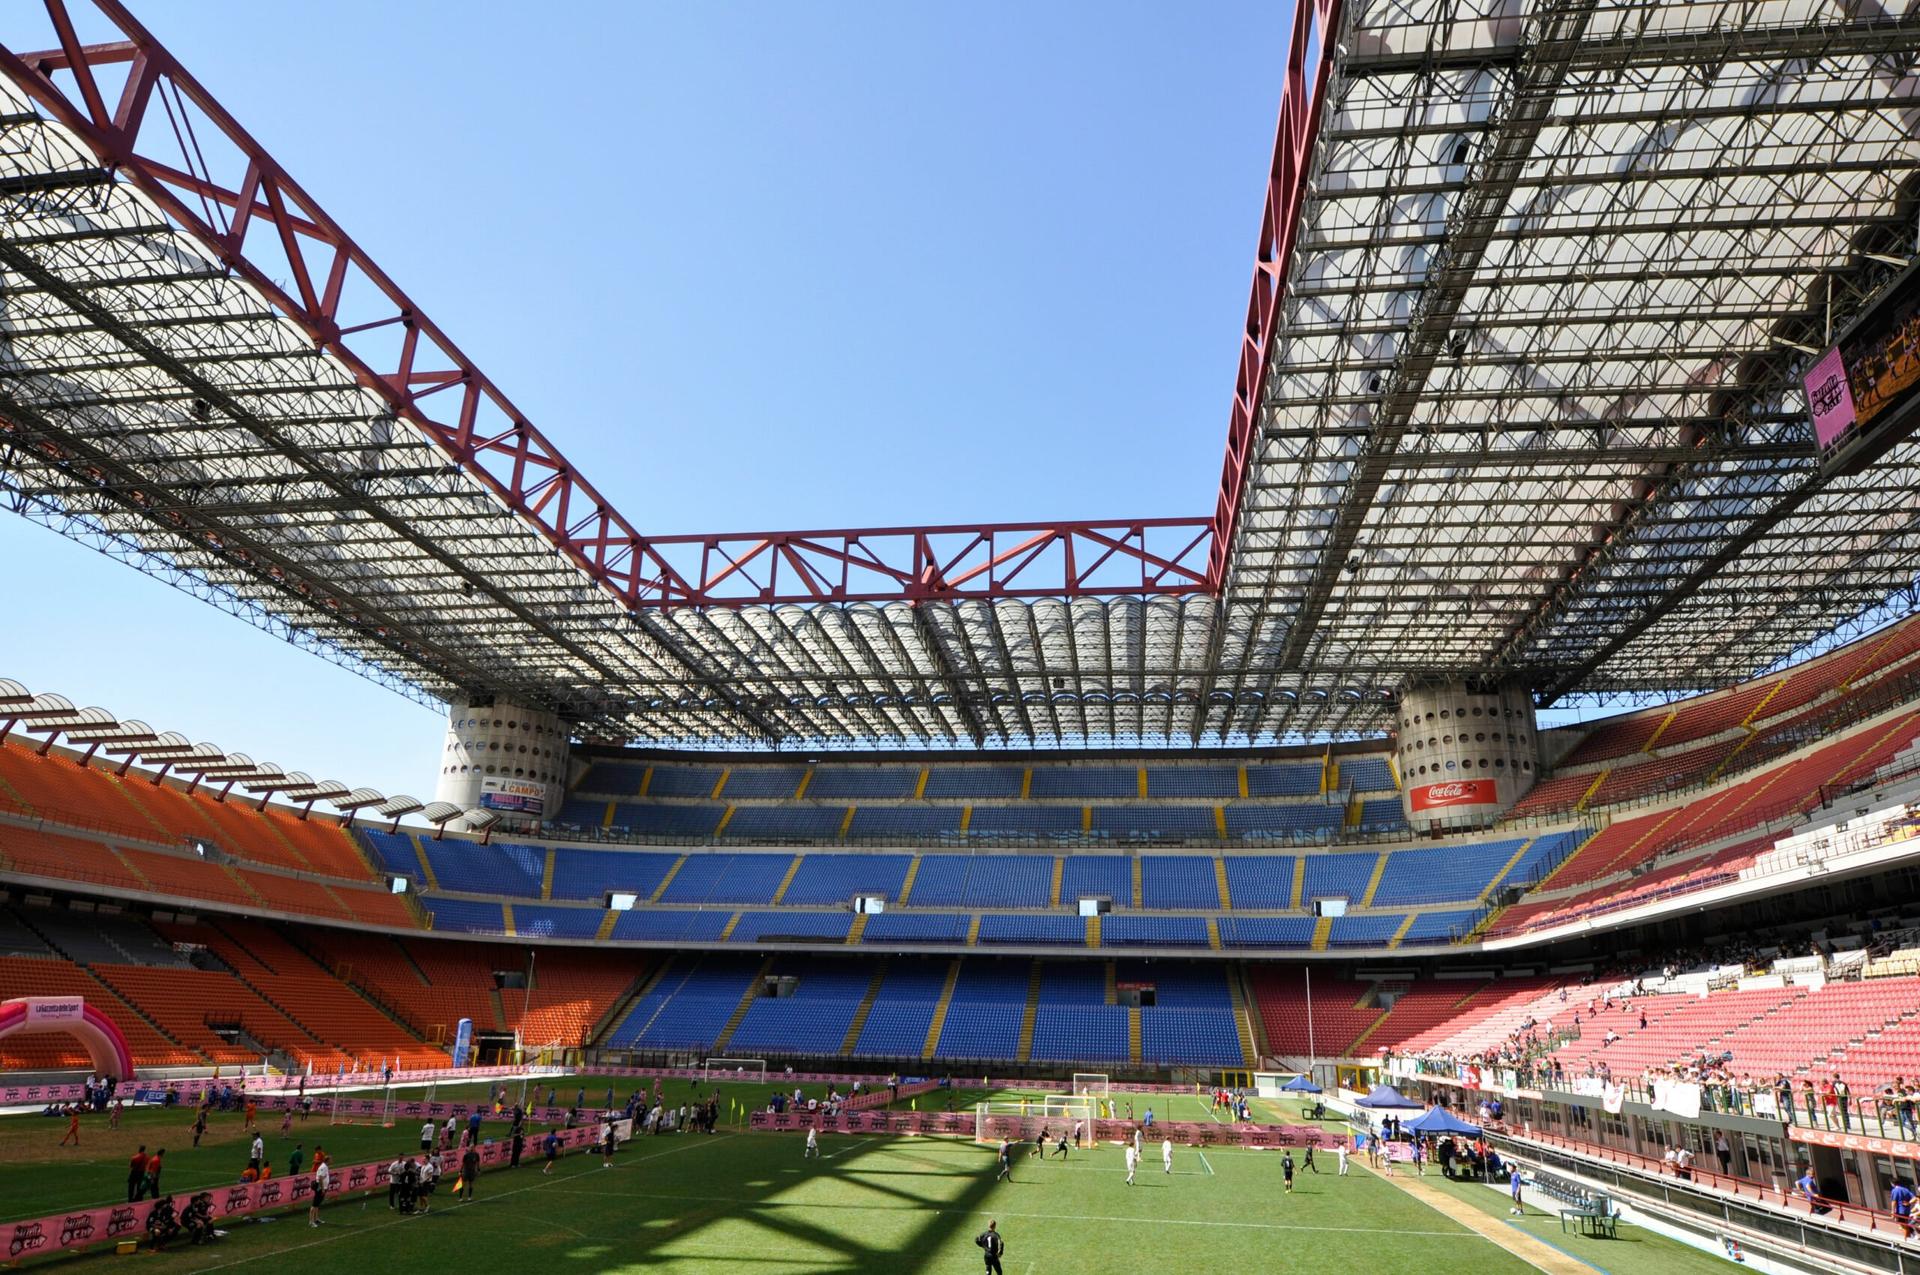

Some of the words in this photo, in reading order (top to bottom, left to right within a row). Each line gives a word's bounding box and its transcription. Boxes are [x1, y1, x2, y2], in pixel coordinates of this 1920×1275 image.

[509, 785, 540, 796] CAMPO
[1428, 783, 1463, 798] Coca-Cola
[987, 1236, 992, 1248] 1
